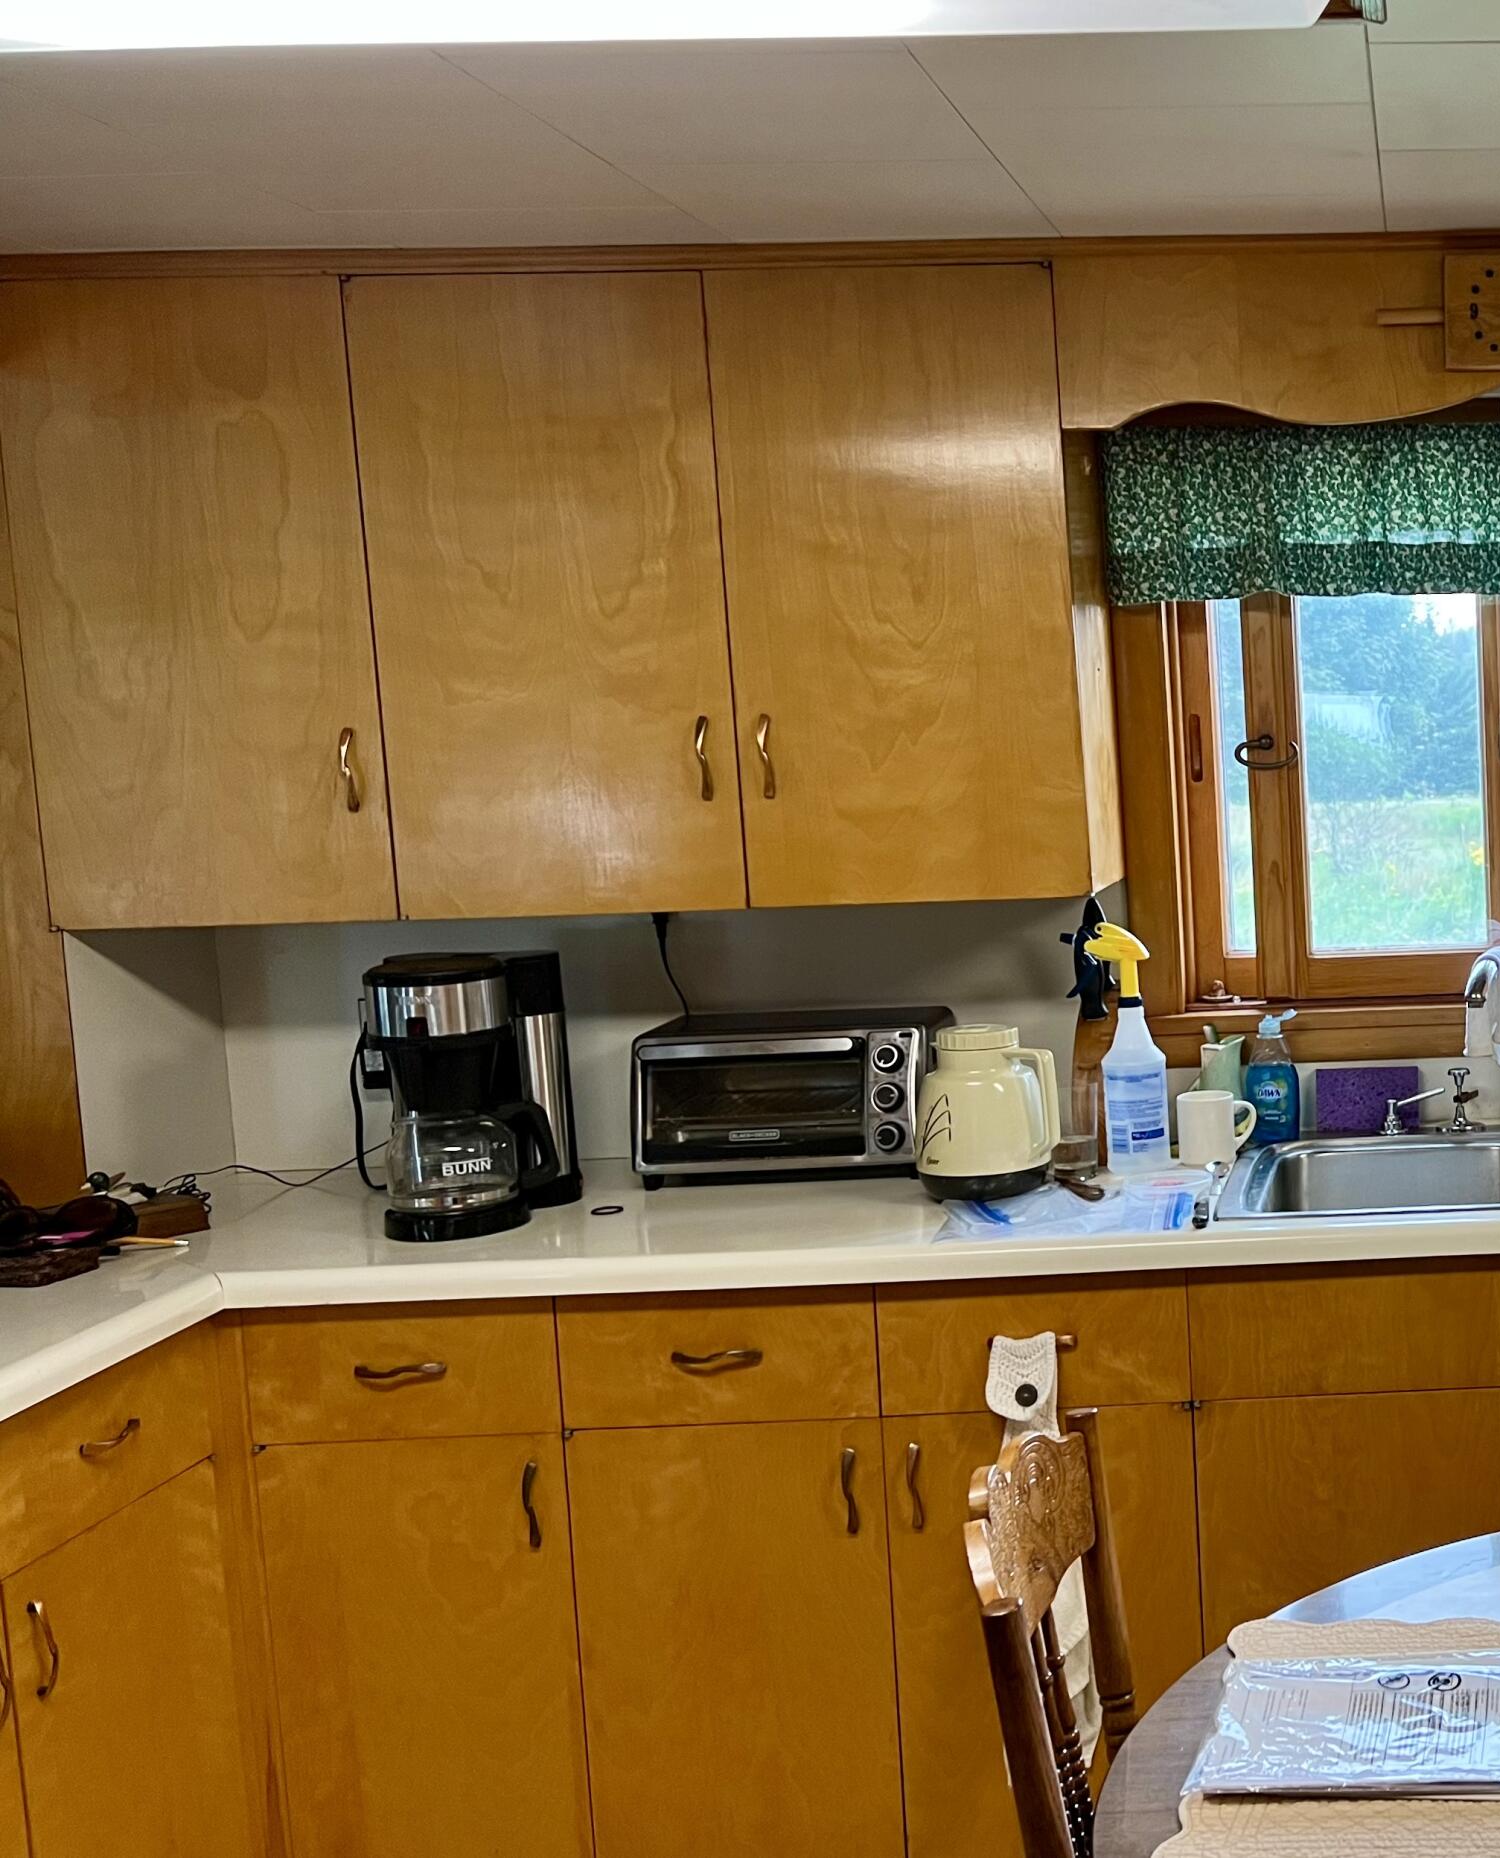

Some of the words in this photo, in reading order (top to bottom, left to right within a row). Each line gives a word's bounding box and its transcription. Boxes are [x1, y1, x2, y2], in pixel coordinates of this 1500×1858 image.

[1470, 303, 1479, 320] 9
[1257, 1088, 1281, 1099] DAWN
[442, 1157, 492, 1176] BUNN
